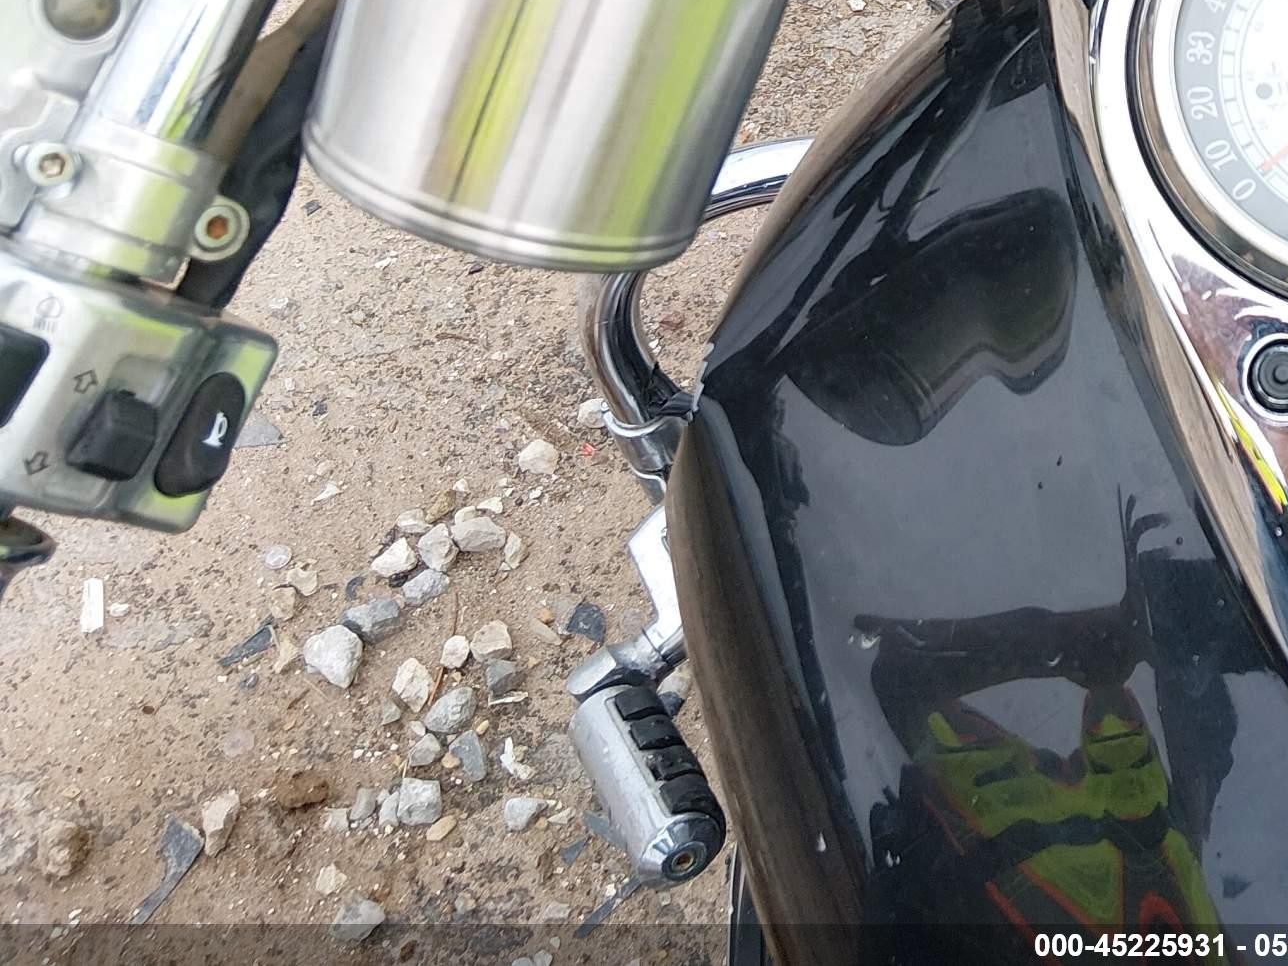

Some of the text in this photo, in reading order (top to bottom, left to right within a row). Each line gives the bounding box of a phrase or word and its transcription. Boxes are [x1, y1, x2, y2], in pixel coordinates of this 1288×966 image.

[1187, 86, 1218, 120] 20
[1205, 139, 1237, 170] 10
[1232, 177, 1257, 201] 0
